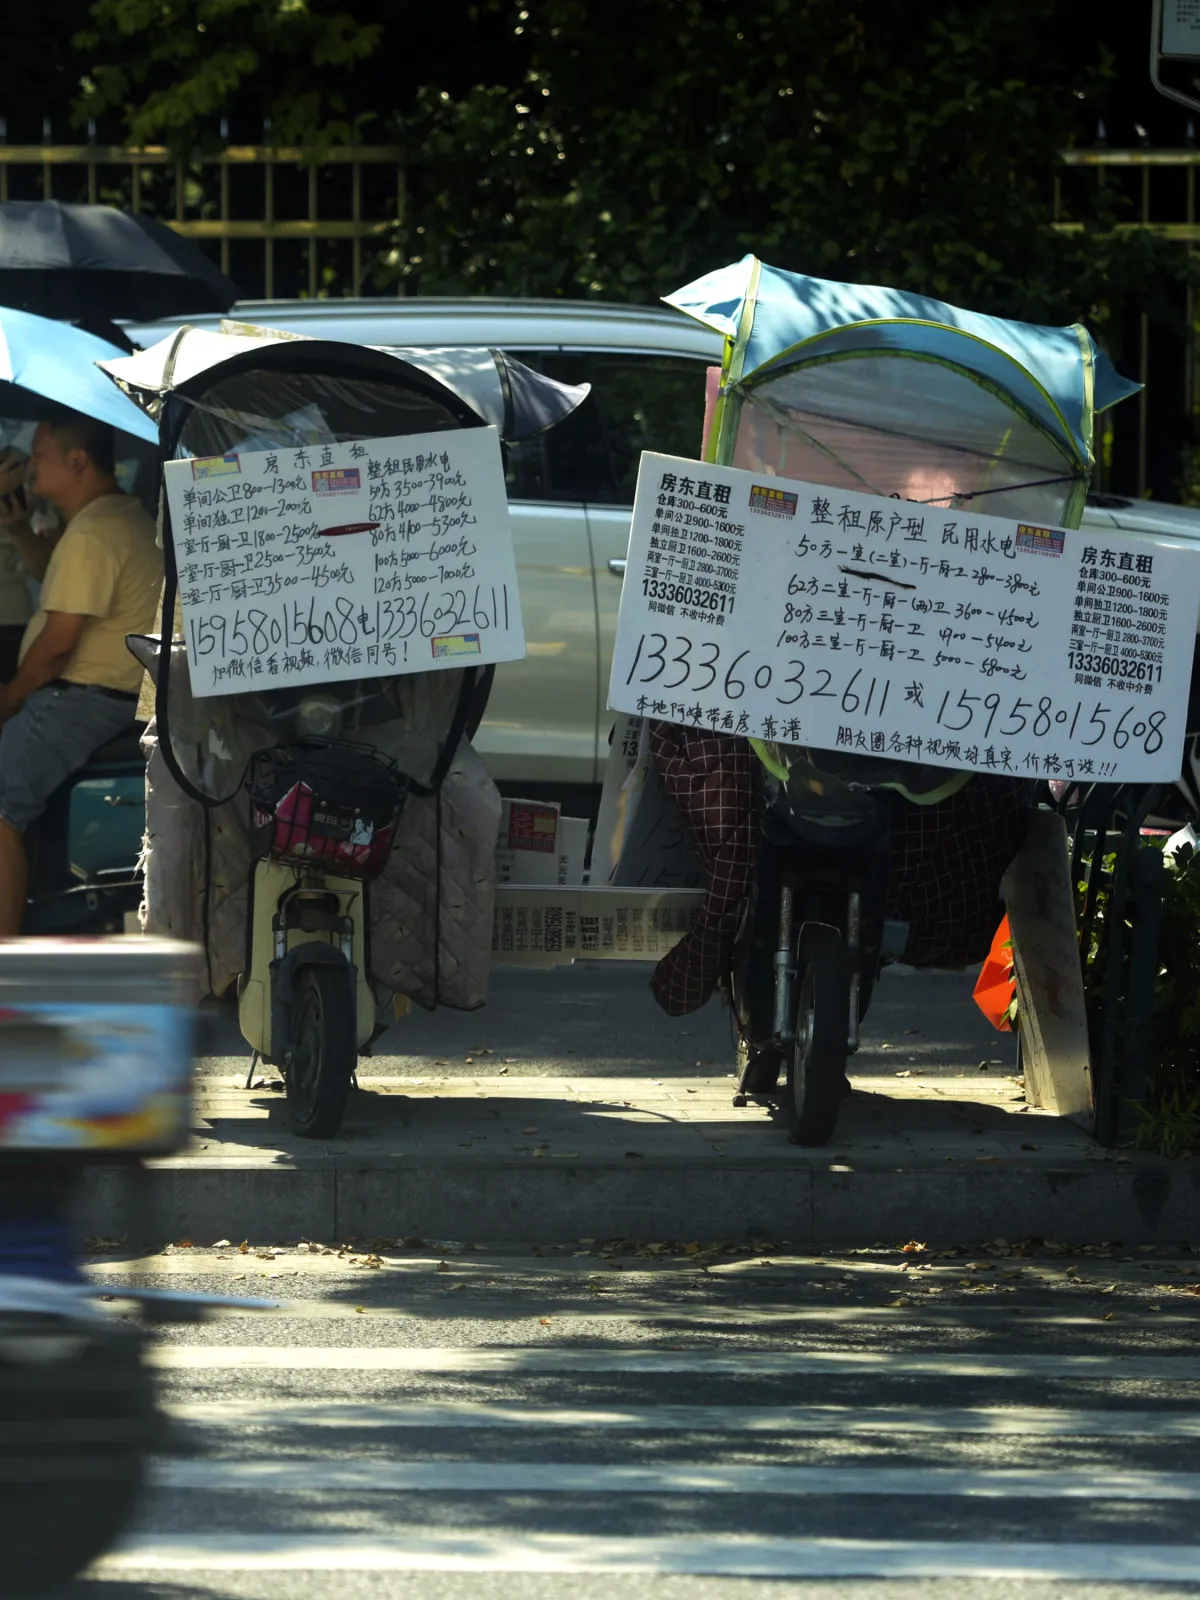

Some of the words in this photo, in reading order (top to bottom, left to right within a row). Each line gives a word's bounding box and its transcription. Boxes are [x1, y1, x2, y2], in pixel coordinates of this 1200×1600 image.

[263, 444, 369, 475] 房东直租
[660, 473, 732, 505] 房东直租
[1081, 545, 1155, 574] 房东直租
[1078, 566, 1152, 588] 仓库300-600元
[642, 578, 735, 615] 13336032611
[1073, 595, 1168, 621] 单间独卫1200-1800元
[1076, 580, 1170, 606] 单间公卫900-1600元
[1067, 651, 1162, 683] 13336032611
[626, 633, 891, 718] 13336032611
[936, 688, 1166, 754] 15958015608
[1074, 673, 1102, 688] 同微信
[1107, 678, 1153, 695] 不收中介费
